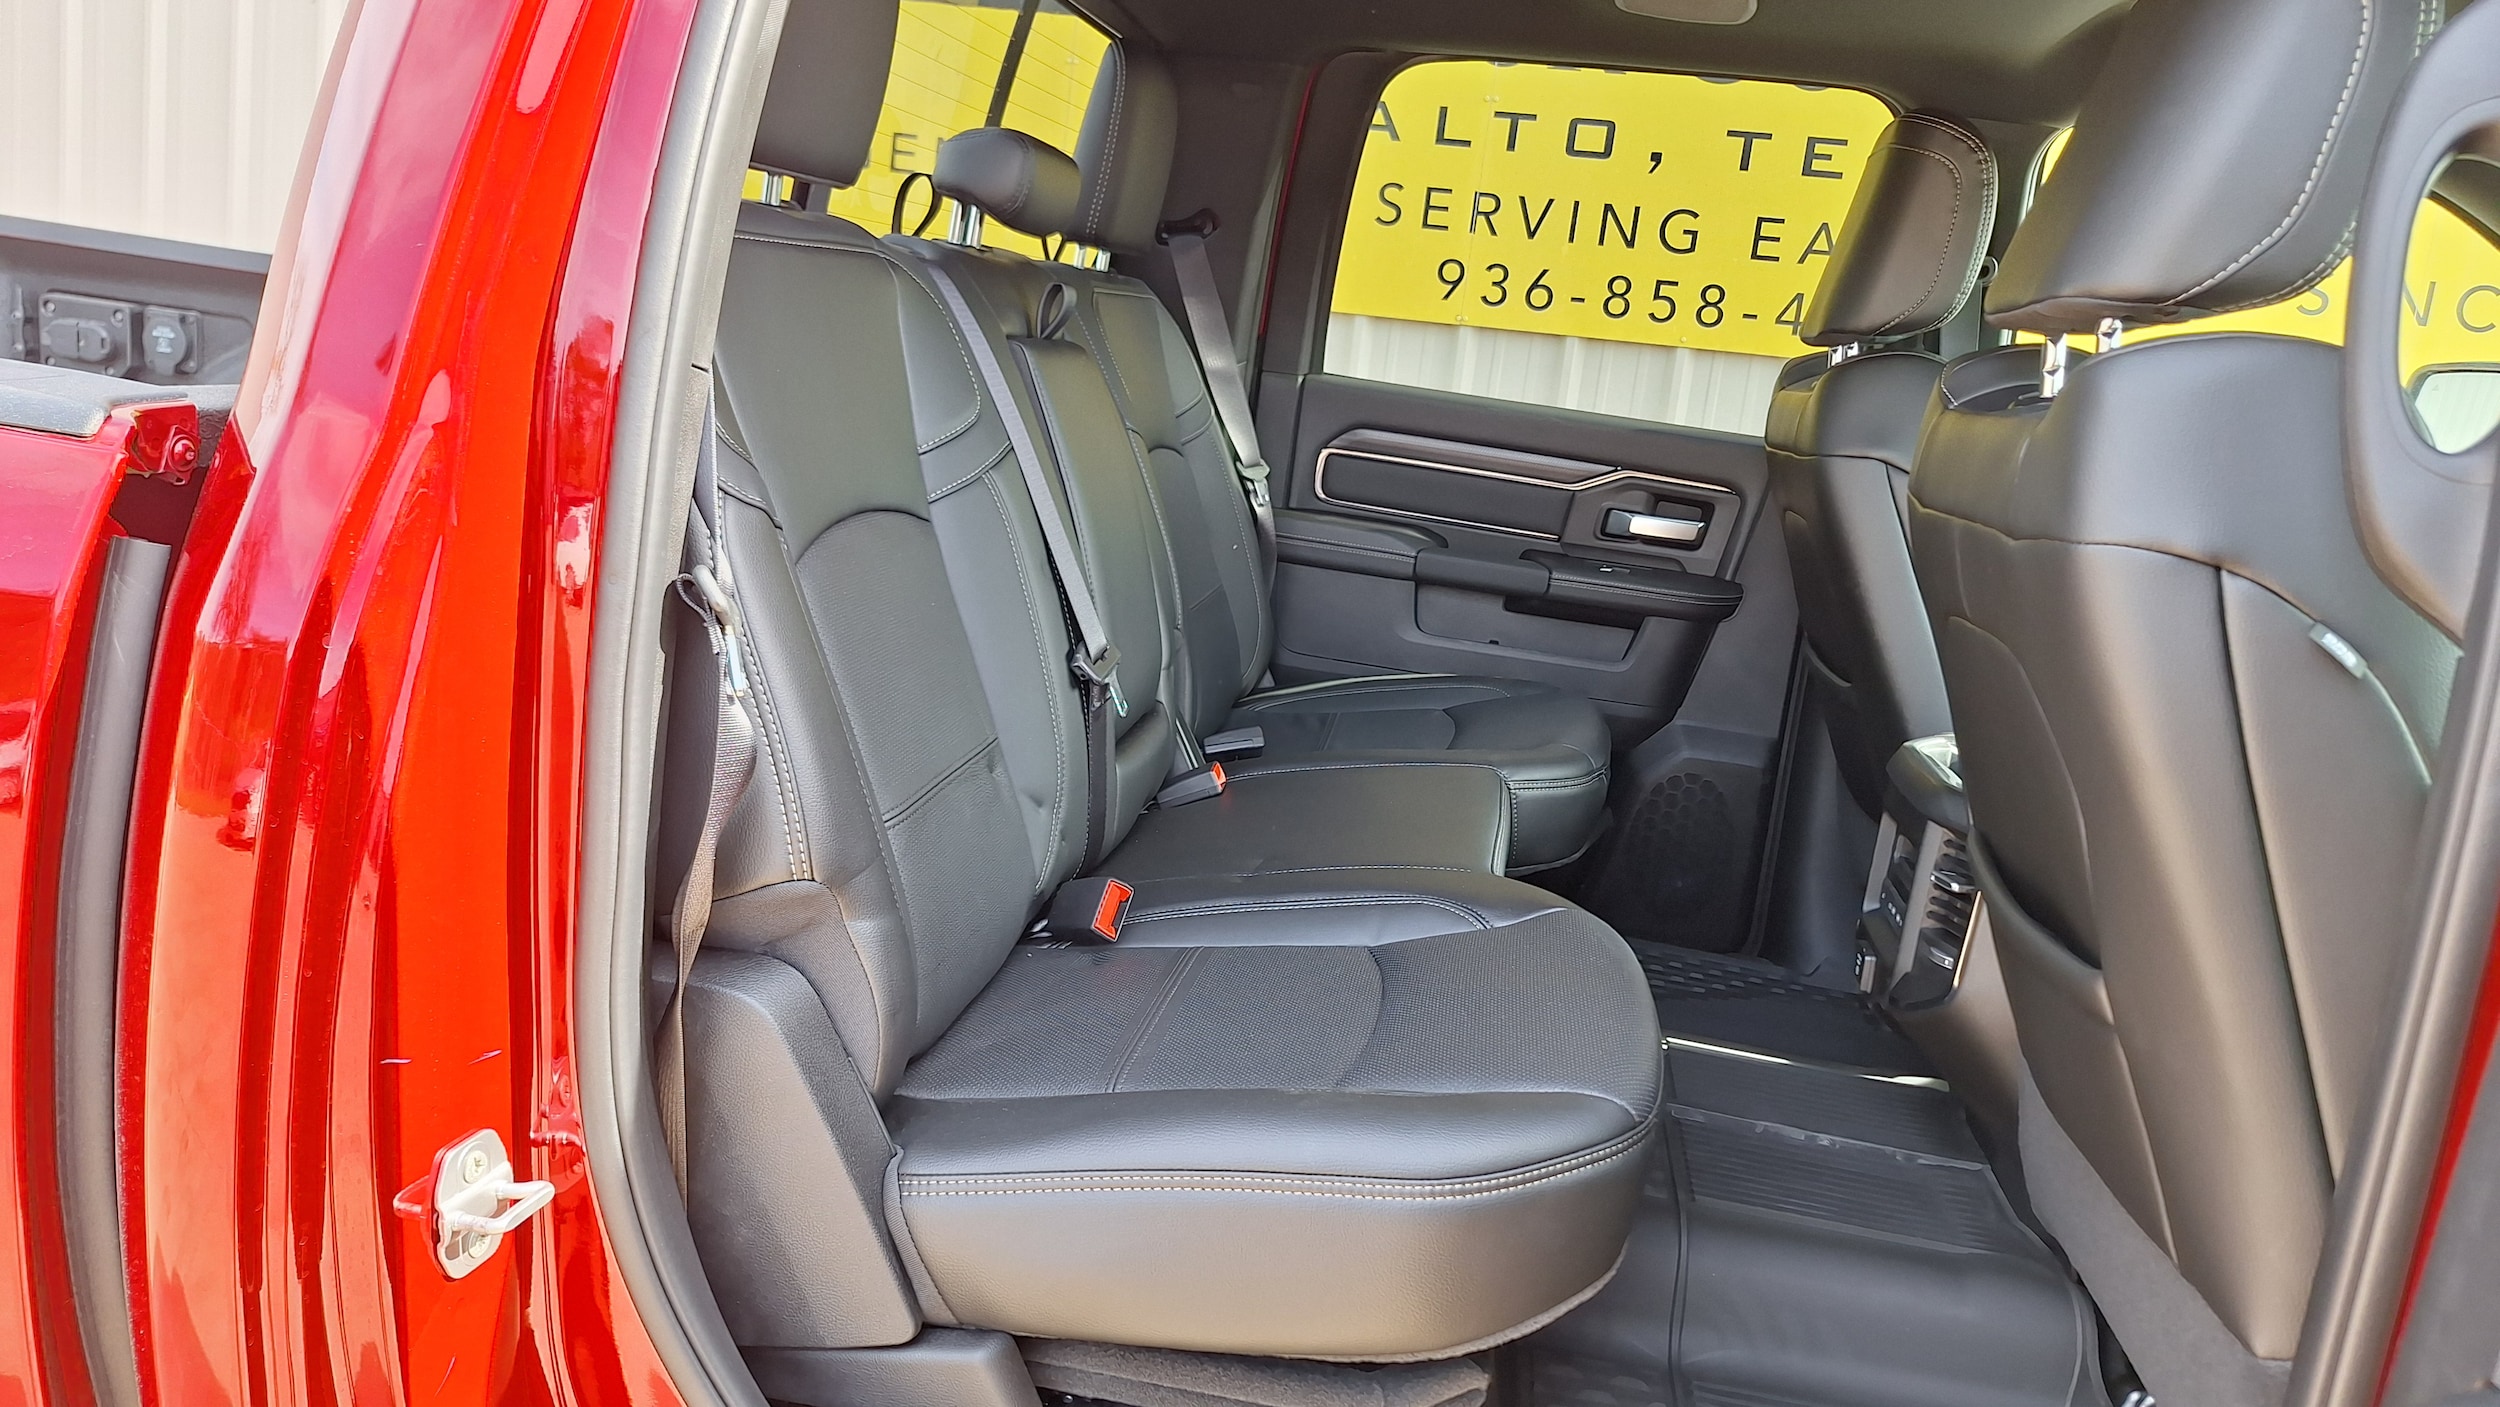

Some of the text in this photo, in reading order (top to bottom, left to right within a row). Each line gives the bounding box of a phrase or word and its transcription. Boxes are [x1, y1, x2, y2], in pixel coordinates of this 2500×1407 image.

[1369, 101, 1662, 174] ALTO,
[1375, 182, 1700, 254] SERVING
[1437, 259, 1803, 336] 936-858-4
